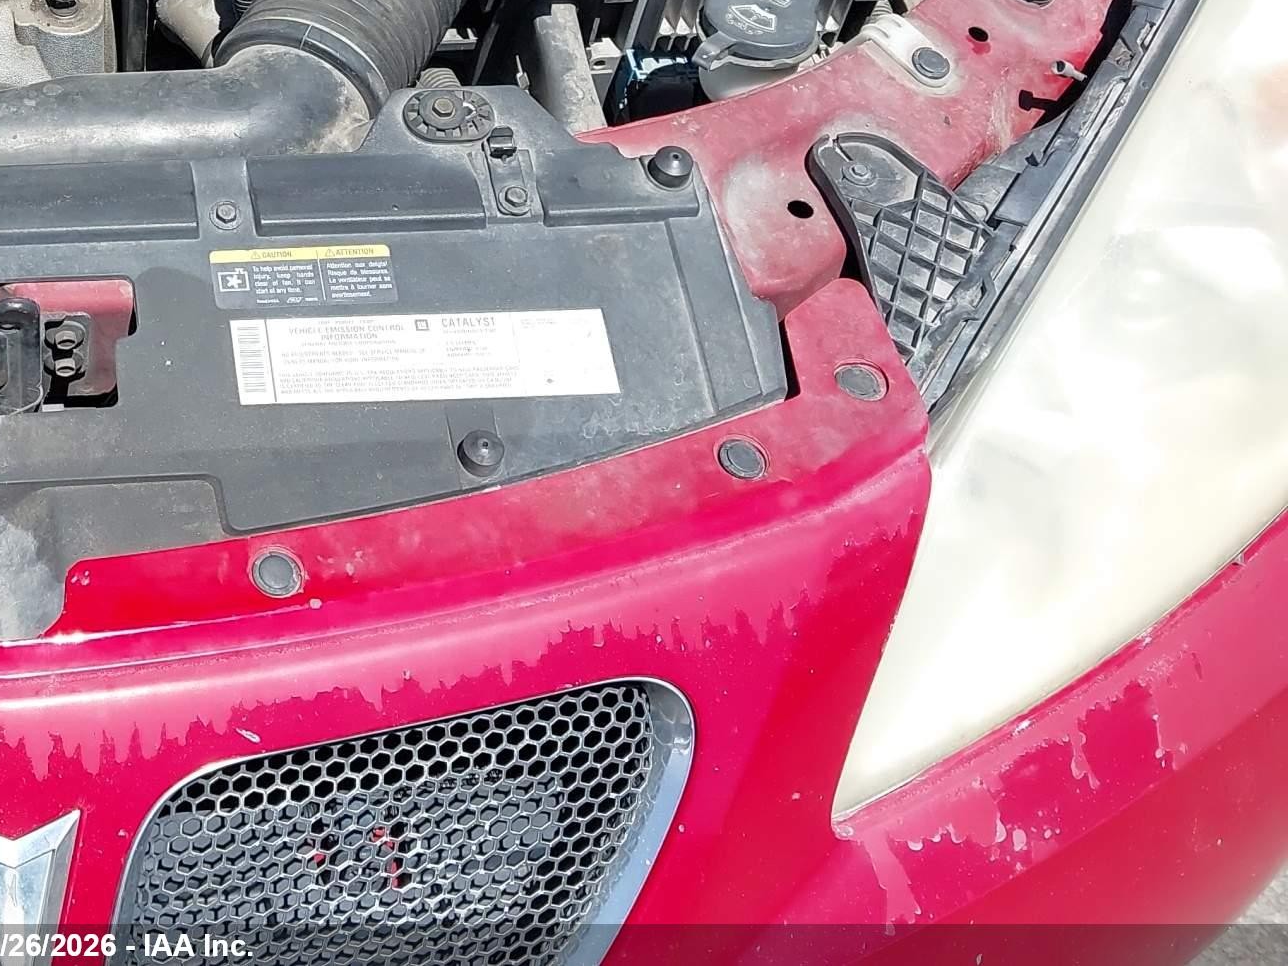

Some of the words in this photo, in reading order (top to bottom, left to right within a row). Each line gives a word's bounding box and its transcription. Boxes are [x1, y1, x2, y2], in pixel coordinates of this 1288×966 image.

[441, 317, 496, 328] CATALYST
[289, 326, 323, 334] VEHICLE
[325, 325, 365, 333] EMISSION
[367, 324, 404, 332] CONTROL
[321, 333, 378, 341] INFORMATION
